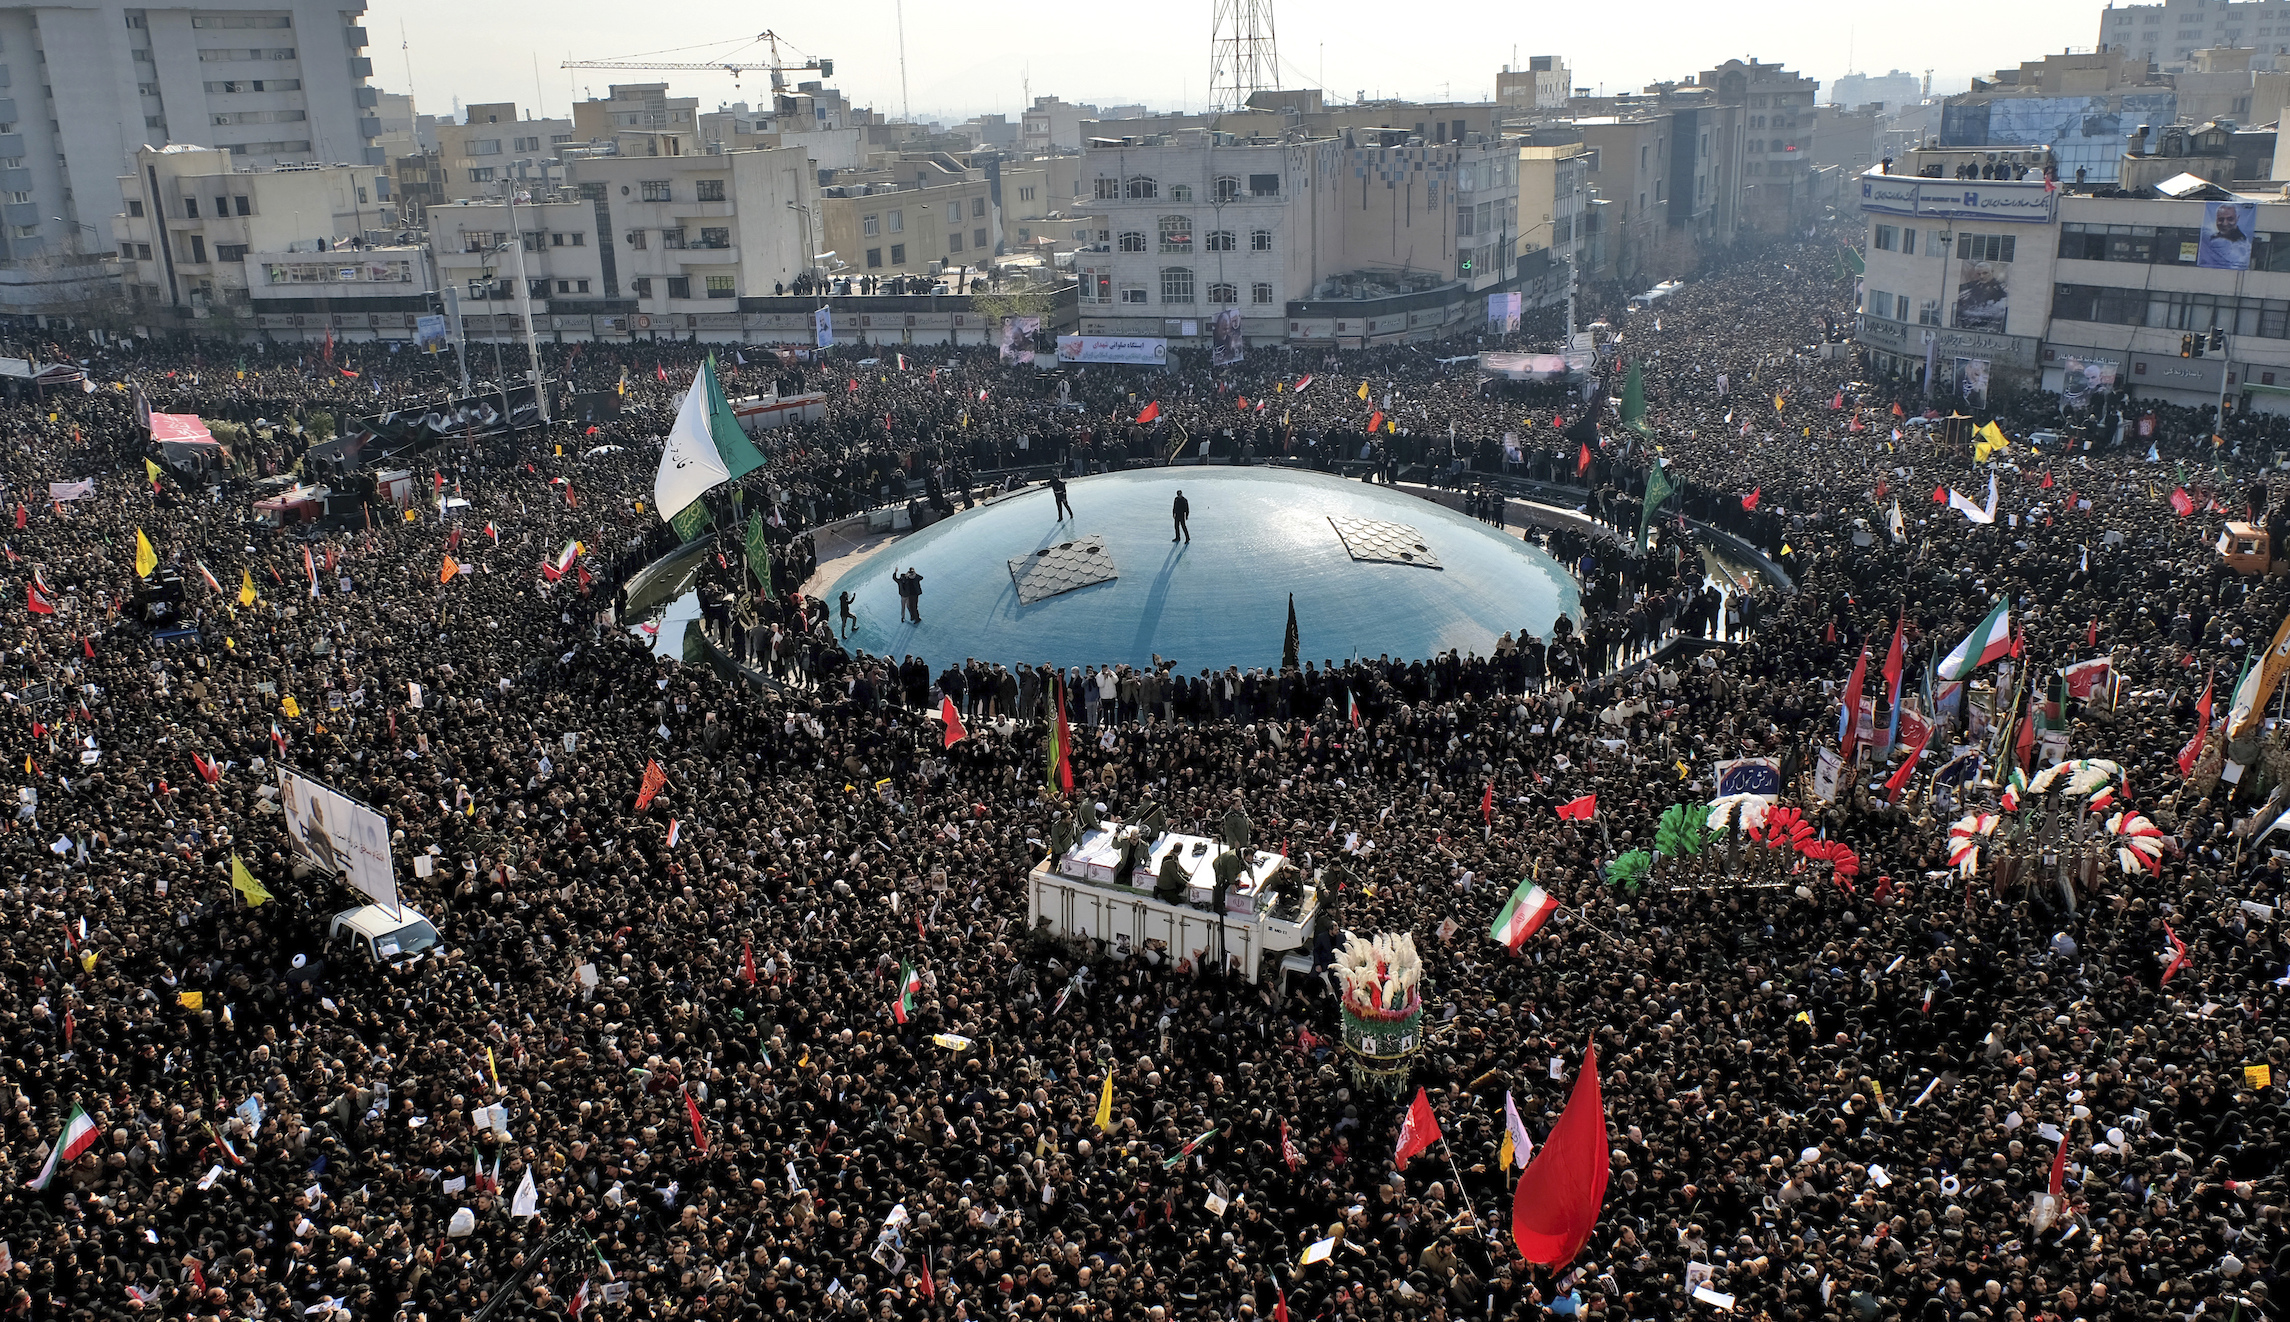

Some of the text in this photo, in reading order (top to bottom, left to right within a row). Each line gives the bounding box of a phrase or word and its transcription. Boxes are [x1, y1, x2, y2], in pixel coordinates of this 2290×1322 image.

[1981, 194, 2050, 210] بانک صادرات ایران
[1961, 334, 1996, 349] صادرات
[1737, 769, 1752, 790] تحول
[1752, 770, 1772, 789] ارتش
